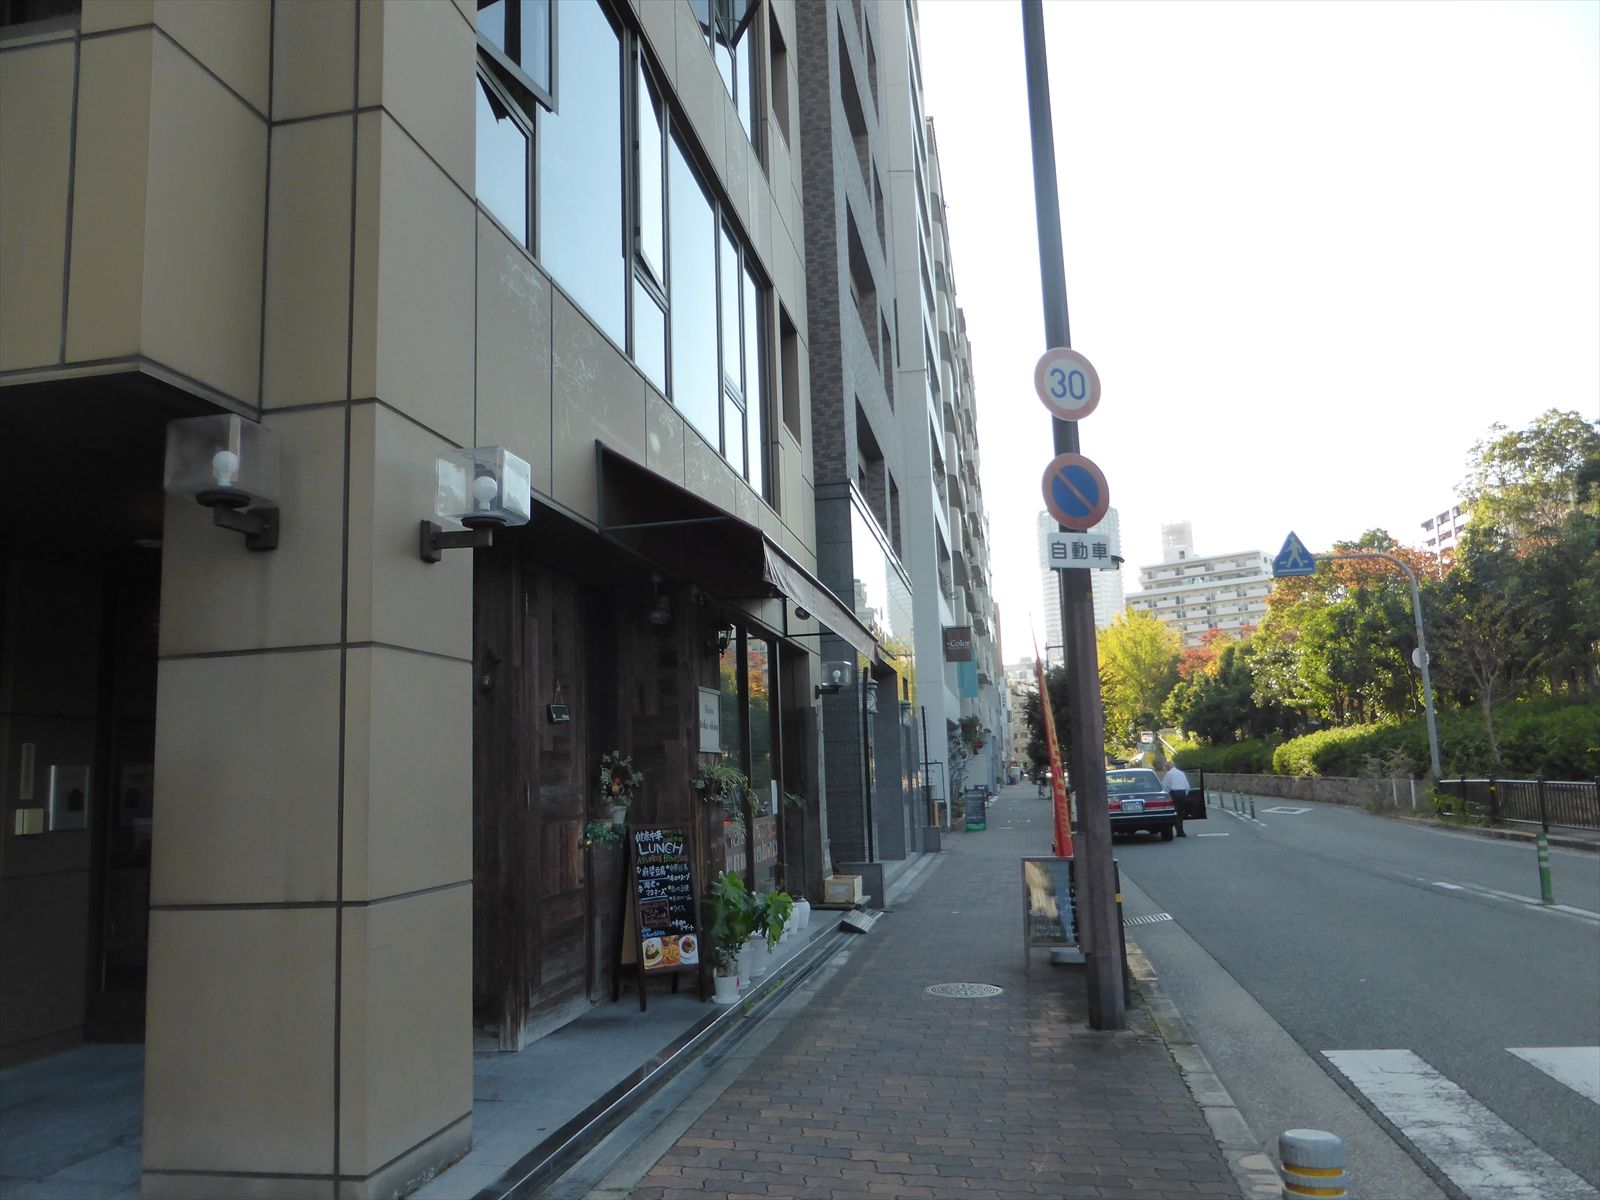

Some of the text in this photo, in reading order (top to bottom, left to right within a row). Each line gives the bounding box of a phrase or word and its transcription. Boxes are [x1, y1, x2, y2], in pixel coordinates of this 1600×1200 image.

[1050, 367, 1086, 401] 30
[1051, 540, 1109, 561] 自動車
[638, 842, 684, 856] LUNCH
